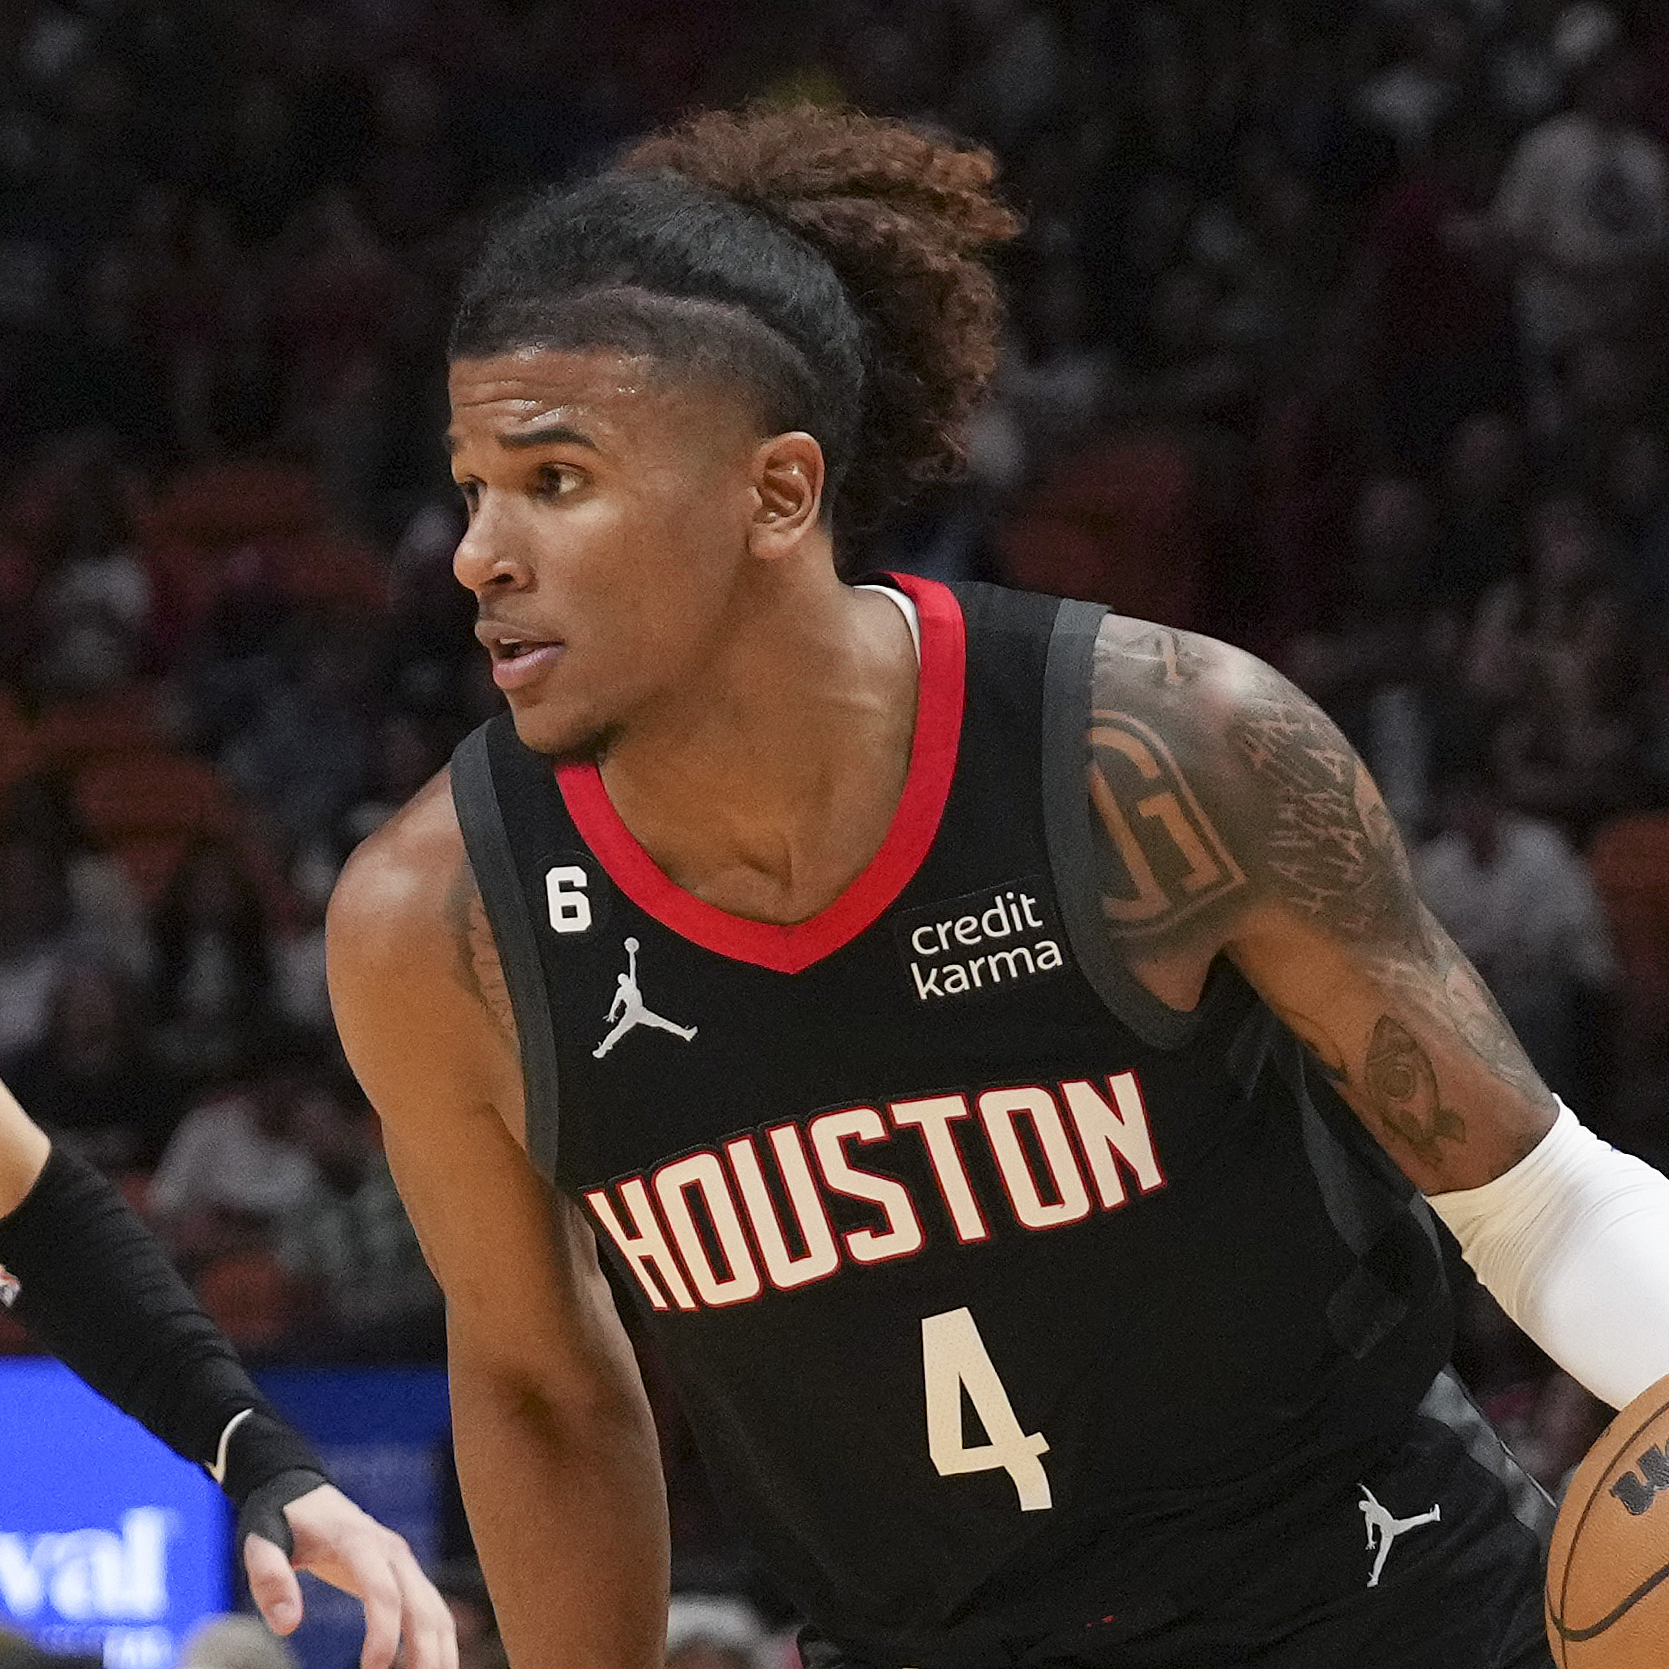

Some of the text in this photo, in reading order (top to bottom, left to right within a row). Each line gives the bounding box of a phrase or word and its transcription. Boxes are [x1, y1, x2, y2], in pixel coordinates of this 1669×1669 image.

[545, 866, 593, 933] 6
[911, 891, 1044, 955] credit
[910, 940, 1064, 1001] karma
[584, 1069, 1167, 1312] HOUSTON
[921, 1306, 1053, 1511] 4
